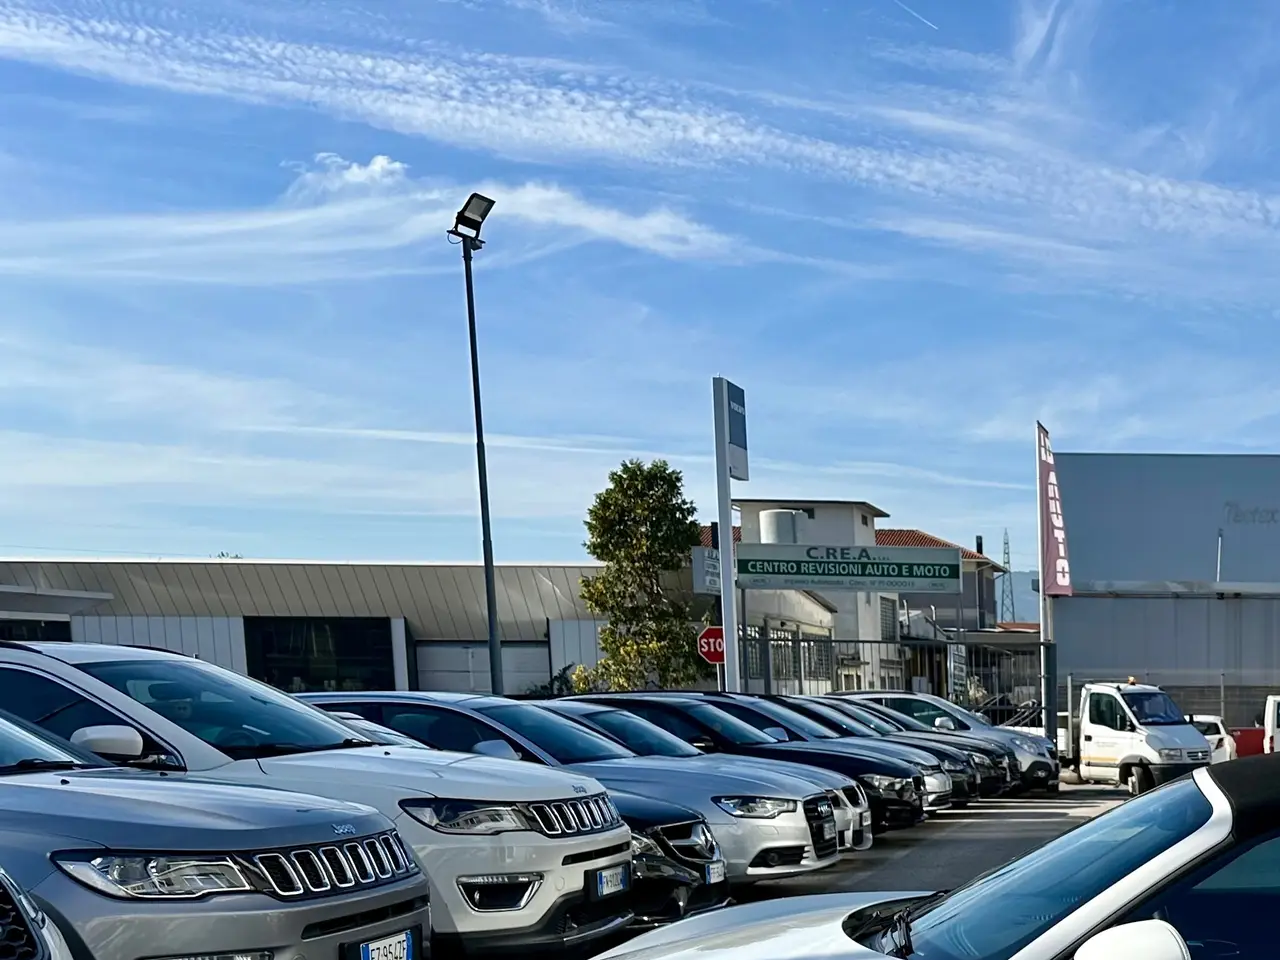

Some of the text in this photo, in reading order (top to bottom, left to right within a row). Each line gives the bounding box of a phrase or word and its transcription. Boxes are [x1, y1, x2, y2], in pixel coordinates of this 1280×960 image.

[1048, 471, 1070, 586] AUTO
[747, 560, 950, 577] CENTRO REVISIONI AUTO E MOTO
[700, 638, 724, 652] STO
[331, 823, 356, 835] Jeep
